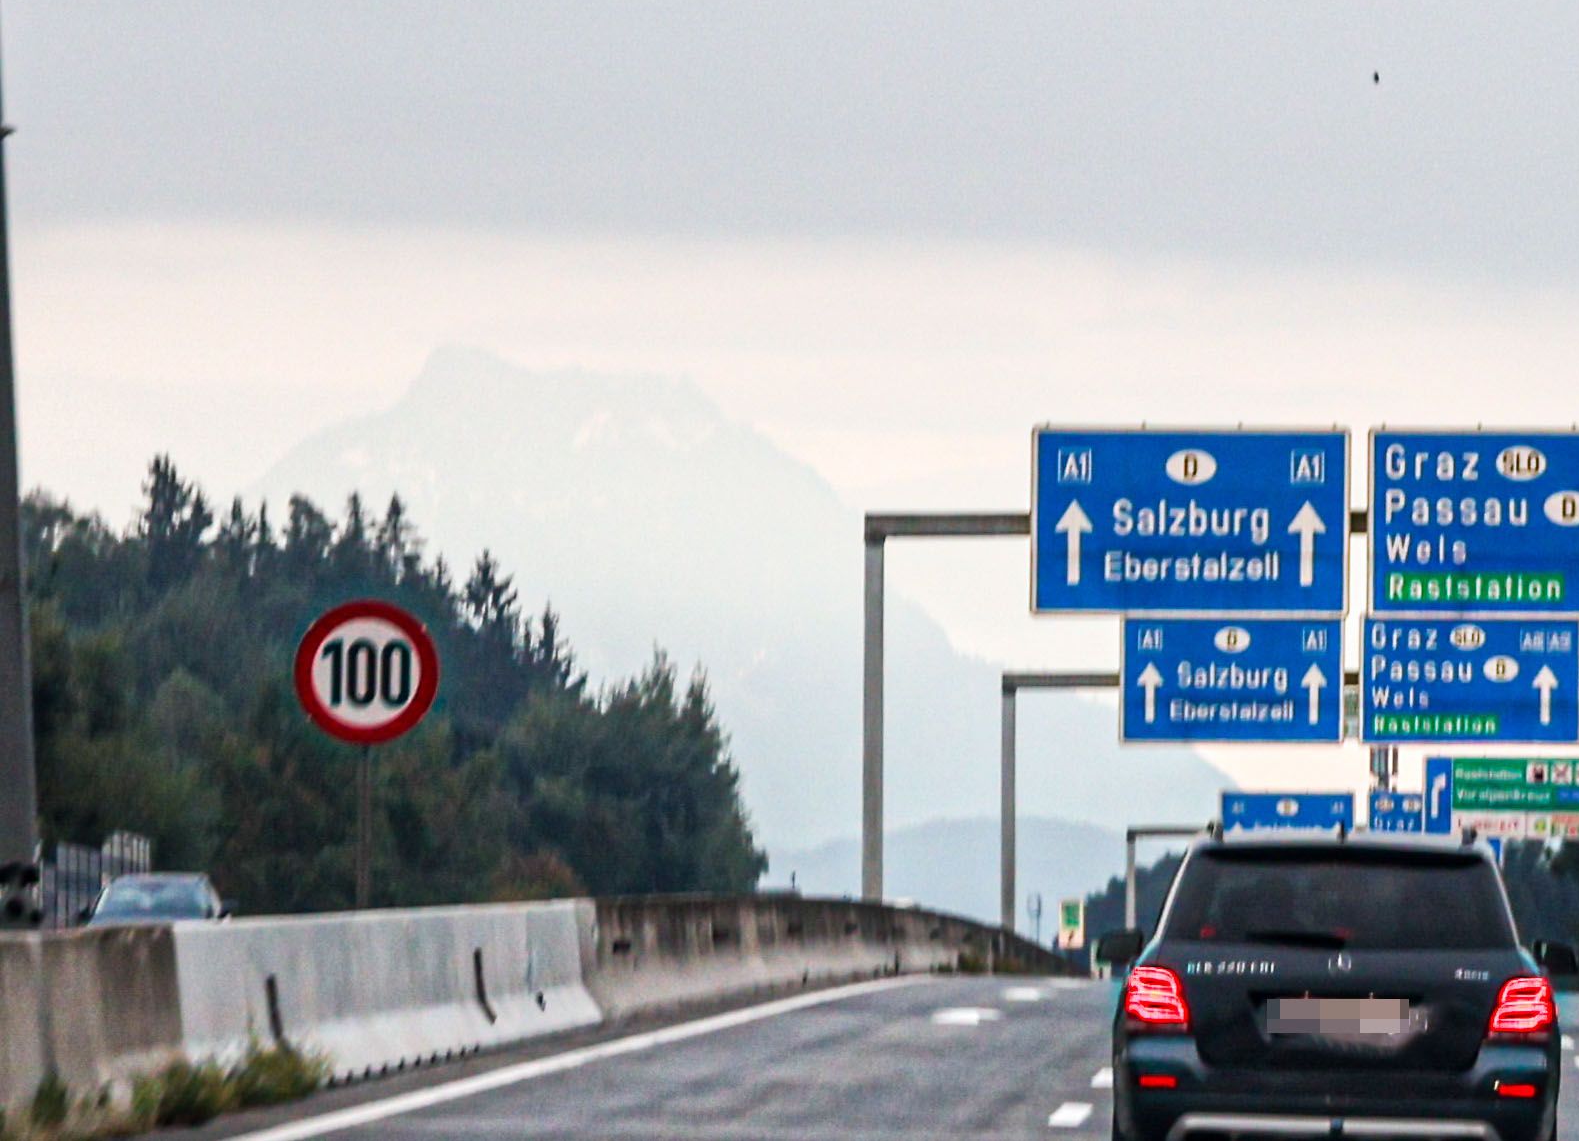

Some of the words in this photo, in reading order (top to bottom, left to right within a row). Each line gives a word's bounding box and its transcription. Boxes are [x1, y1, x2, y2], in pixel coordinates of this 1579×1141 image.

[1063, 453, 1087, 480] A1
[1183, 453, 1198, 478] D
[1296, 454, 1321, 480] A1
[1385, 443, 1479, 481] Graz
[1502, 452, 1540, 476] SLO
[1112, 498, 1270, 545] Salzburg
[1385, 488, 1528, 526] Passau
[1561, 496, 1576, 520] D
[1386, 533, 1467, 564] Wels
[1104, 551, 1279, 581] Eberstalzell
[1389, 573, 1561, 600] Raststation
[1371, 623, 1437, 650] Graz
[321, 637, 412, 707] 100
[1177, 661, 1288, 695] Salzburg
[1371, 654, 1473, 683] Passau
[1372, 686, 1430, 708] Wels
